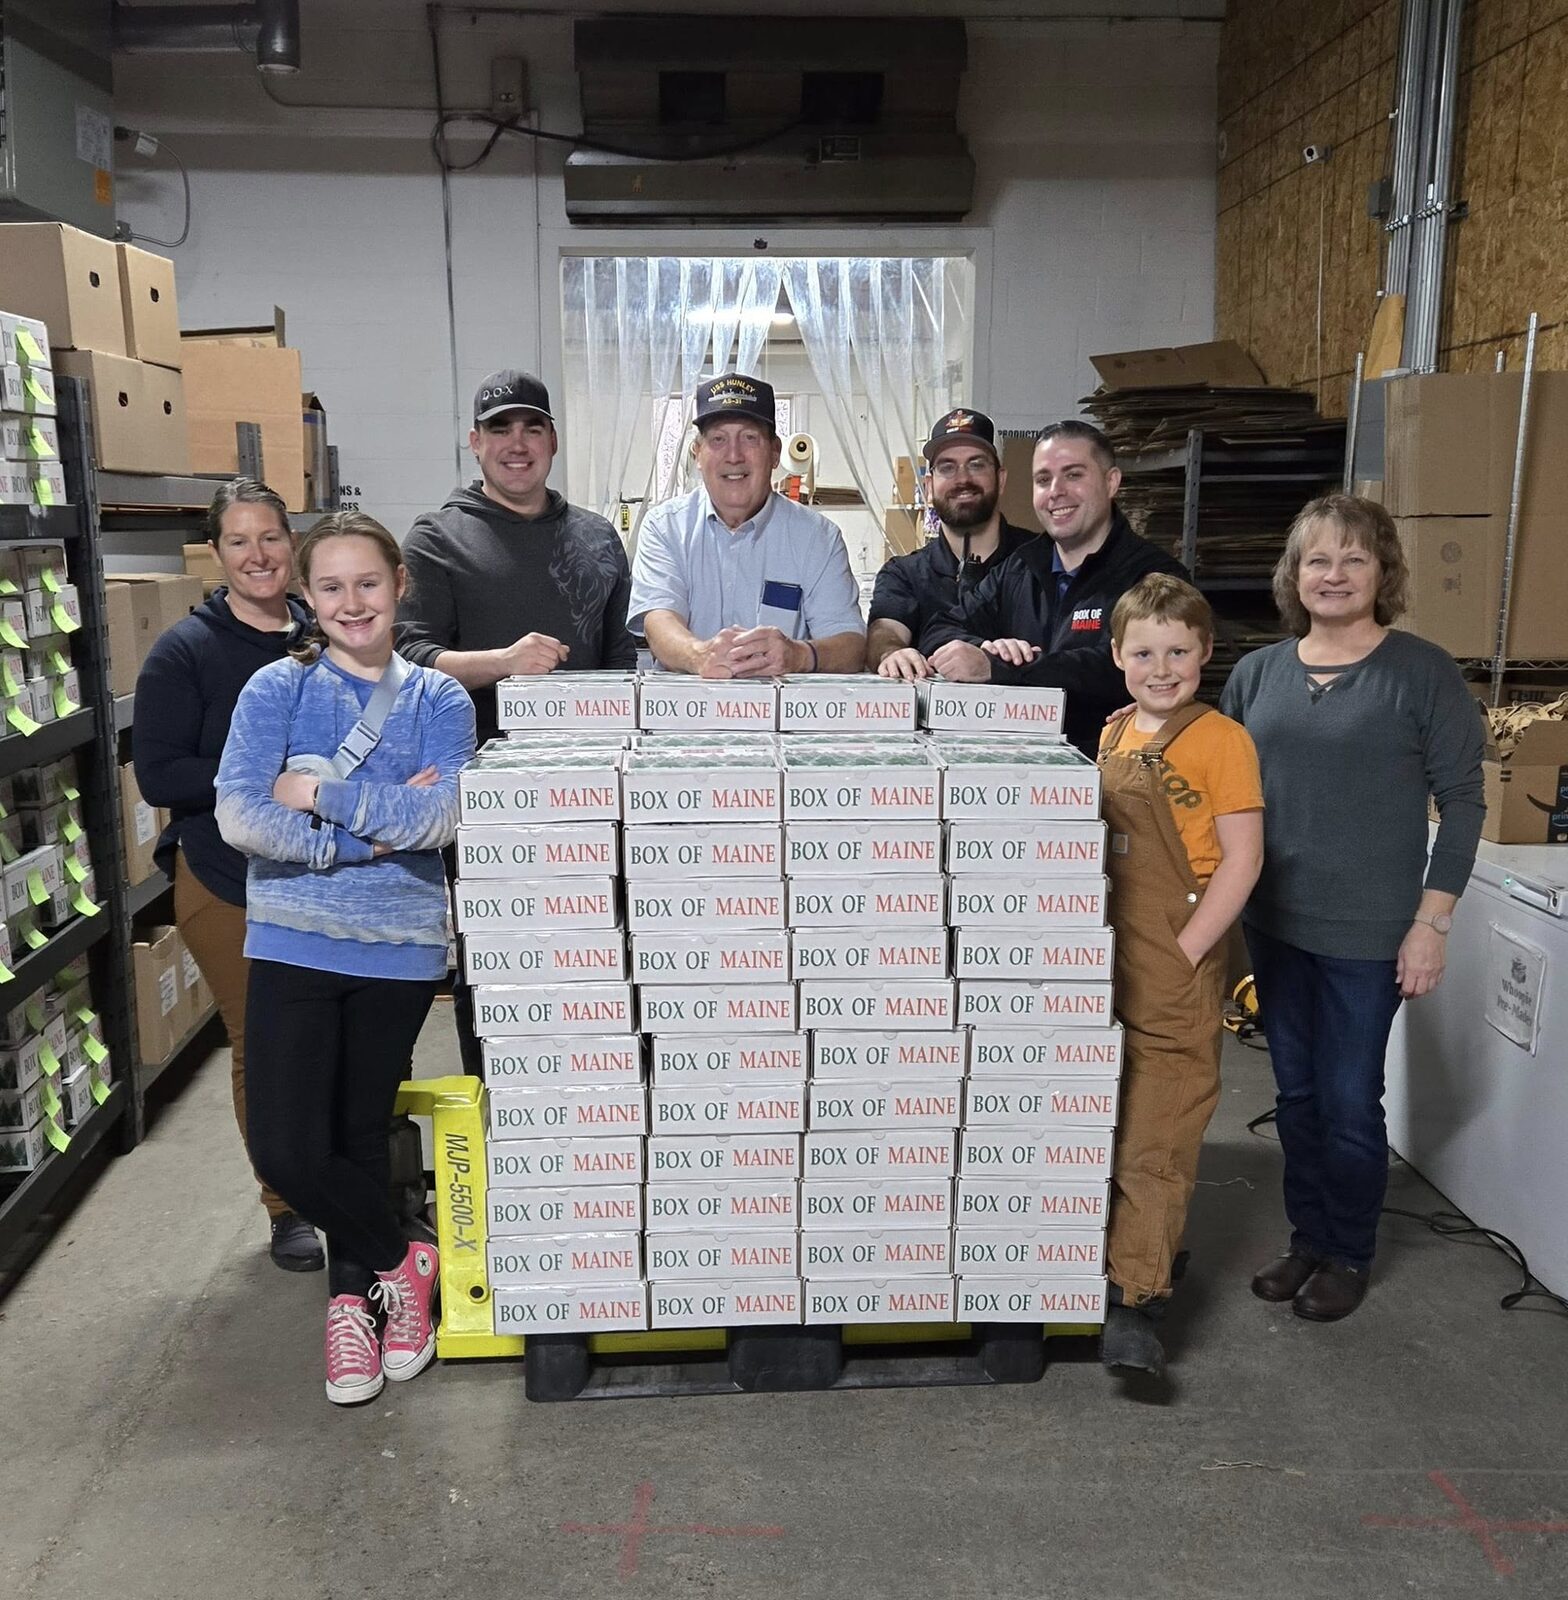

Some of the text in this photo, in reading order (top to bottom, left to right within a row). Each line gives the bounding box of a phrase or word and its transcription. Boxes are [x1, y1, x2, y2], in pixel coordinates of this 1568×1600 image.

[710, 379, 756, 395] USS HUNLEY
[354, 486, 361, 496] &
[1073, 608, 1102, 620] BOX OF
[1071, 619, 1101, 630] MAINE
[504, 700, 630, 717] BOX OF MAINE
[645, 700, 771, 718] BOX OF MAINE
[785, 702, 910, 718] BOX OF MAINE
[934, 700, 1058, 721] BOX OF MAINE
[465, 788, 614, 809] BOX OF MAINE
[629, 789, 775, 810] BOX OF MAINE
[790, 787, 934, 807] BOX OF MAINE
[950, 786, 1093, 806] BOX OF MAINE
[464, 844, 609, 864] BOX OF MAINE
[631, 844, 775, 864] BOX OF MAINE
[791, 841, 934, 860] BOX OF MAINE
[956, 841, 1099, 859] BOX OF MAINE
[11, 879, 25, 901] BOX
[463, 895, 608, 918] BOX OF MAINE
[795, 894, 938, 914] BOX OF MAINE
[957, 895, 1099, 913] BOX OF MAINE
[472, 952, 511, 970] BOX
[520, 951, 543, 969] OF
[554, 949, 617, 967] MAINE
[639, 951, 783, 970] BOX OF MAINE
[799, 947, 941, 966] BOX OF MAINE
[963, 947, 1105, 965] BOX OF MAINE
[480, 1001, 626, 1023] BOX OF MAINE
[646, 1000, 790, 1019] BOX OF MAINE
[965, 995, 1105, 1013] BOX OF MAINE
[490, 1052, 634, 1075] BOX OF MAINE
[661, 1050, 801, 1071] BOX OF MAINE
[821, 1046, 960, 1065] BOX OF MAINE
[978, 1045, 1116, 1063] BOX OF MAINE
[24, 1052, 36, 1076] BOX
[817, 1097, 956, 1117] BOX OF MAINE
[973, 1095, 1112, 1113] BOX OF MAINE
[496, 1104, 640, 1127] BOX OF MAINE
[493, 1153, 636, 1175] BOX OF MAINE
[654, 1148, 794, 1169] BOX OF MAINE
[967, 1146, 1106, 1164] BOX OF MAINE
[445, 1133, 478, 1251] MJP-5500-X
[493, 1201, 635, 1222] BOX OF MAINE
[808, 1195, 945, 1214] BOX OF MAINE
[963, 1195, 1102, 1214] BOX OF MAINE
[493, 1251, 633, 1273] BOX OF MAINE
[653, 1248, 791, 1268] BOX OF MAINE
[808, 1244, 945, 1263] BOX OF MAINE
[961, 1245, 1098, 1262] BOX OF MAINE
[500, 1301, 640, 1322] BOX OF MAINE
[657, 1295, 795, 1315] BOX OF MAINE
[812, 1294, 948, 1313] BOX OF MAINE
[964, 1294, 1100, 1311] BOX OF MAINE
